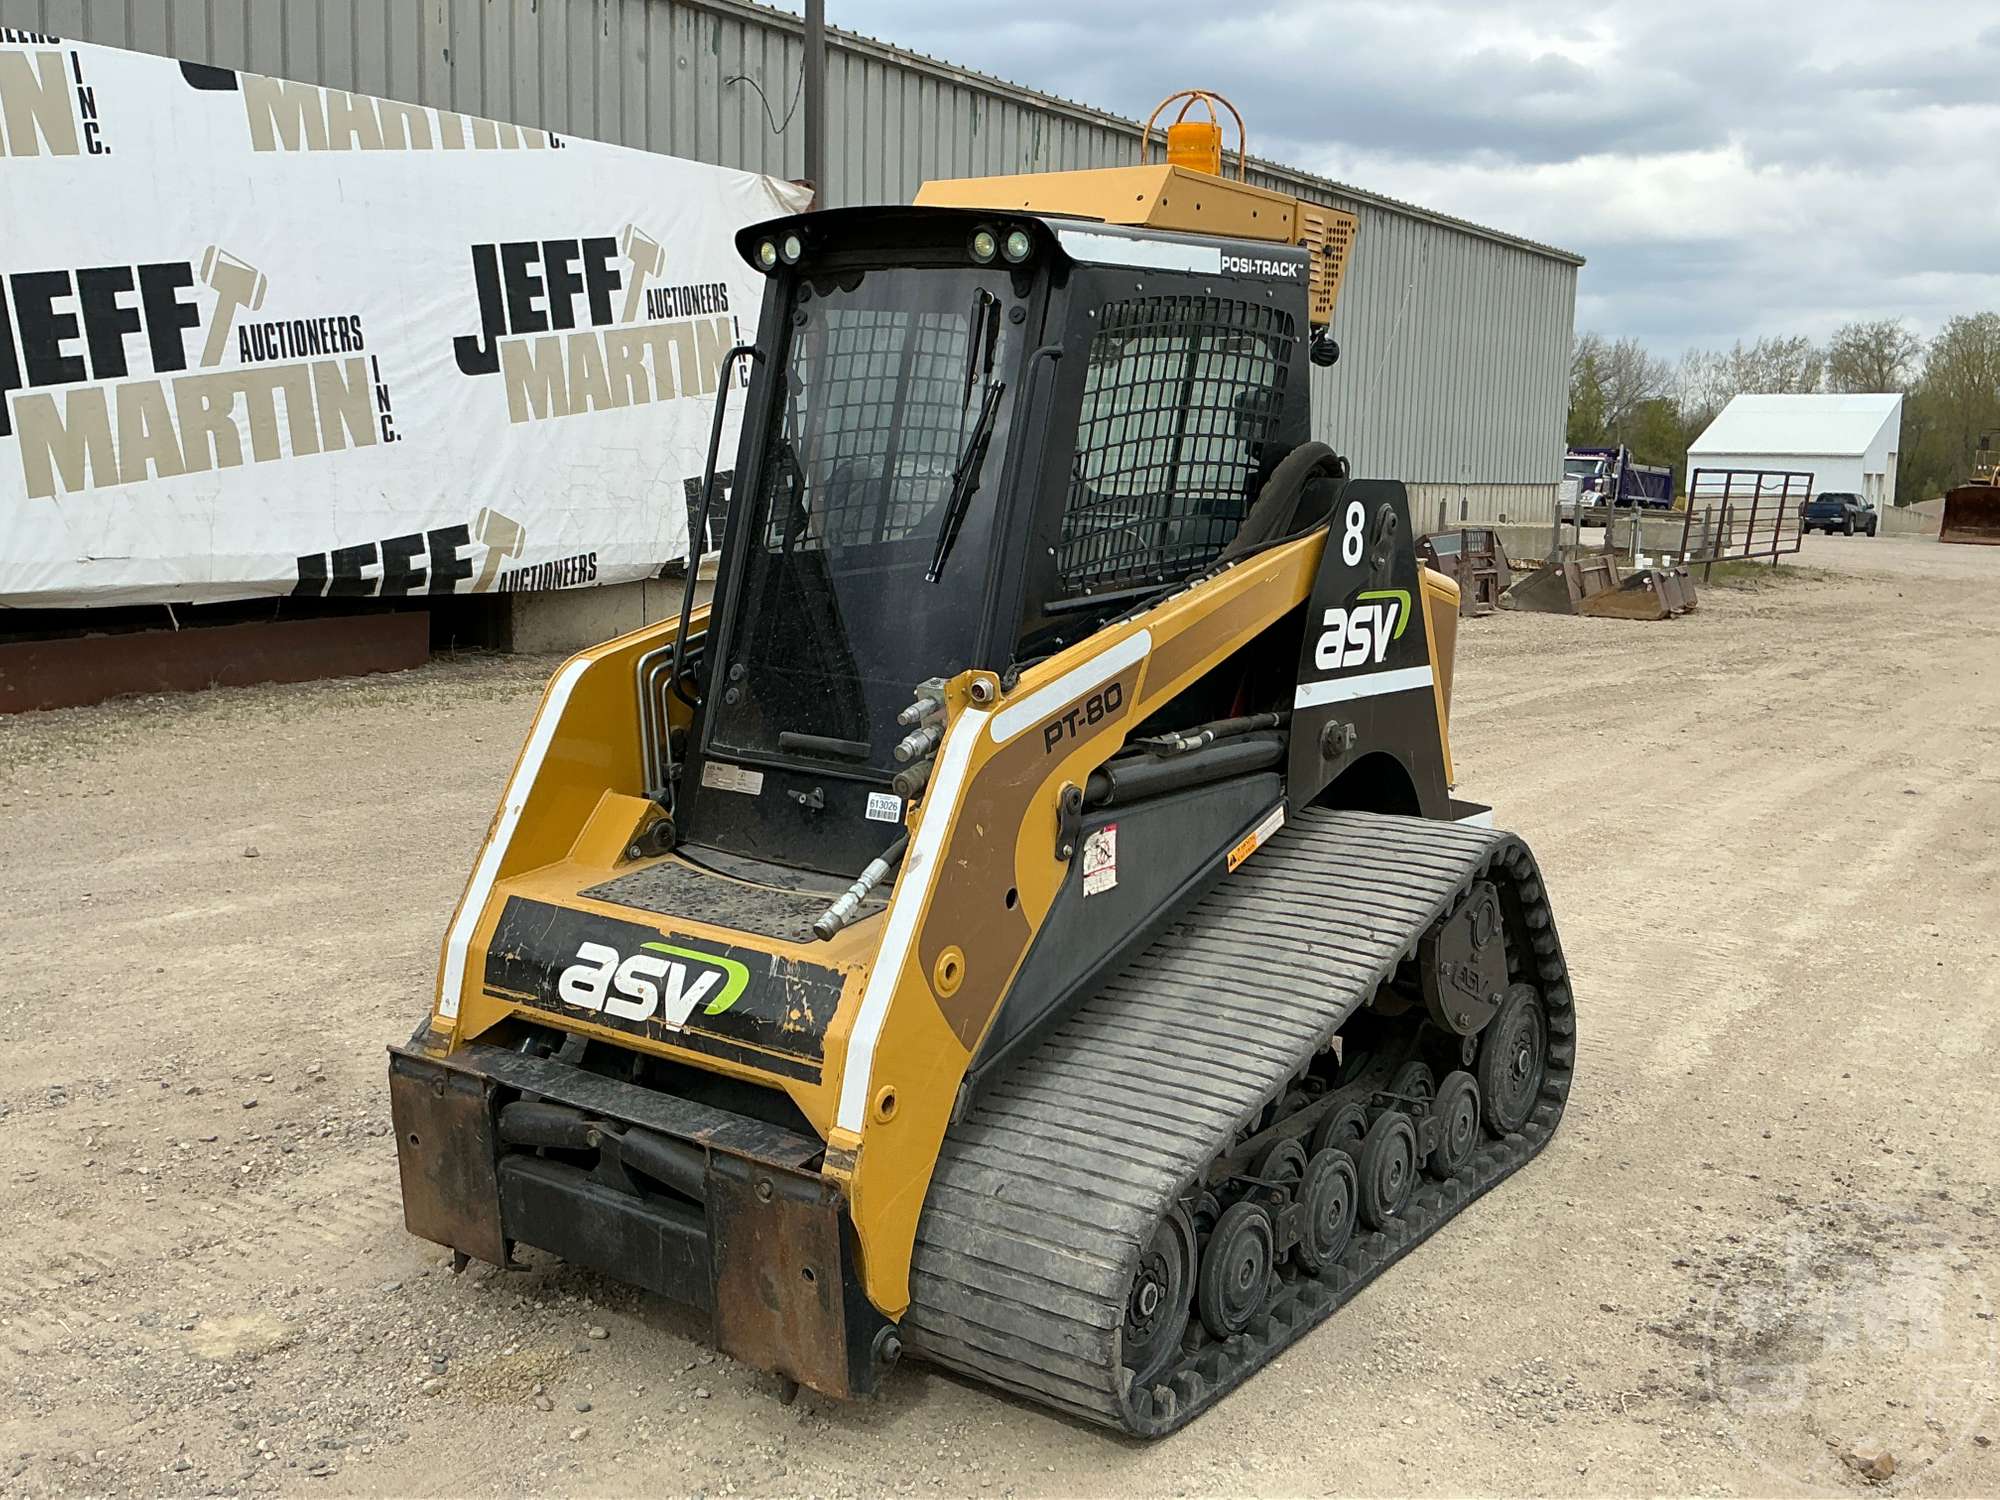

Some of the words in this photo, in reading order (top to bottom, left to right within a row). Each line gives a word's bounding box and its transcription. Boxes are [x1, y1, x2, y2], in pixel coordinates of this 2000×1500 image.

[452, 236, 623, 376] JEFF
[646, 283, 729, 320] AUCTIONEERS
[238, 315, 365, 364] AUCTIONEERS
[500, 317, 737, 424] MARTIN
[13, 357, 377, 499] MARTIN
[371, 354, 402, 443] INC.
[1342, 500, 1366, 567] 8
[1044, 683, 1123, 754] PT-80
[869, 798, 898, 811] 613026
